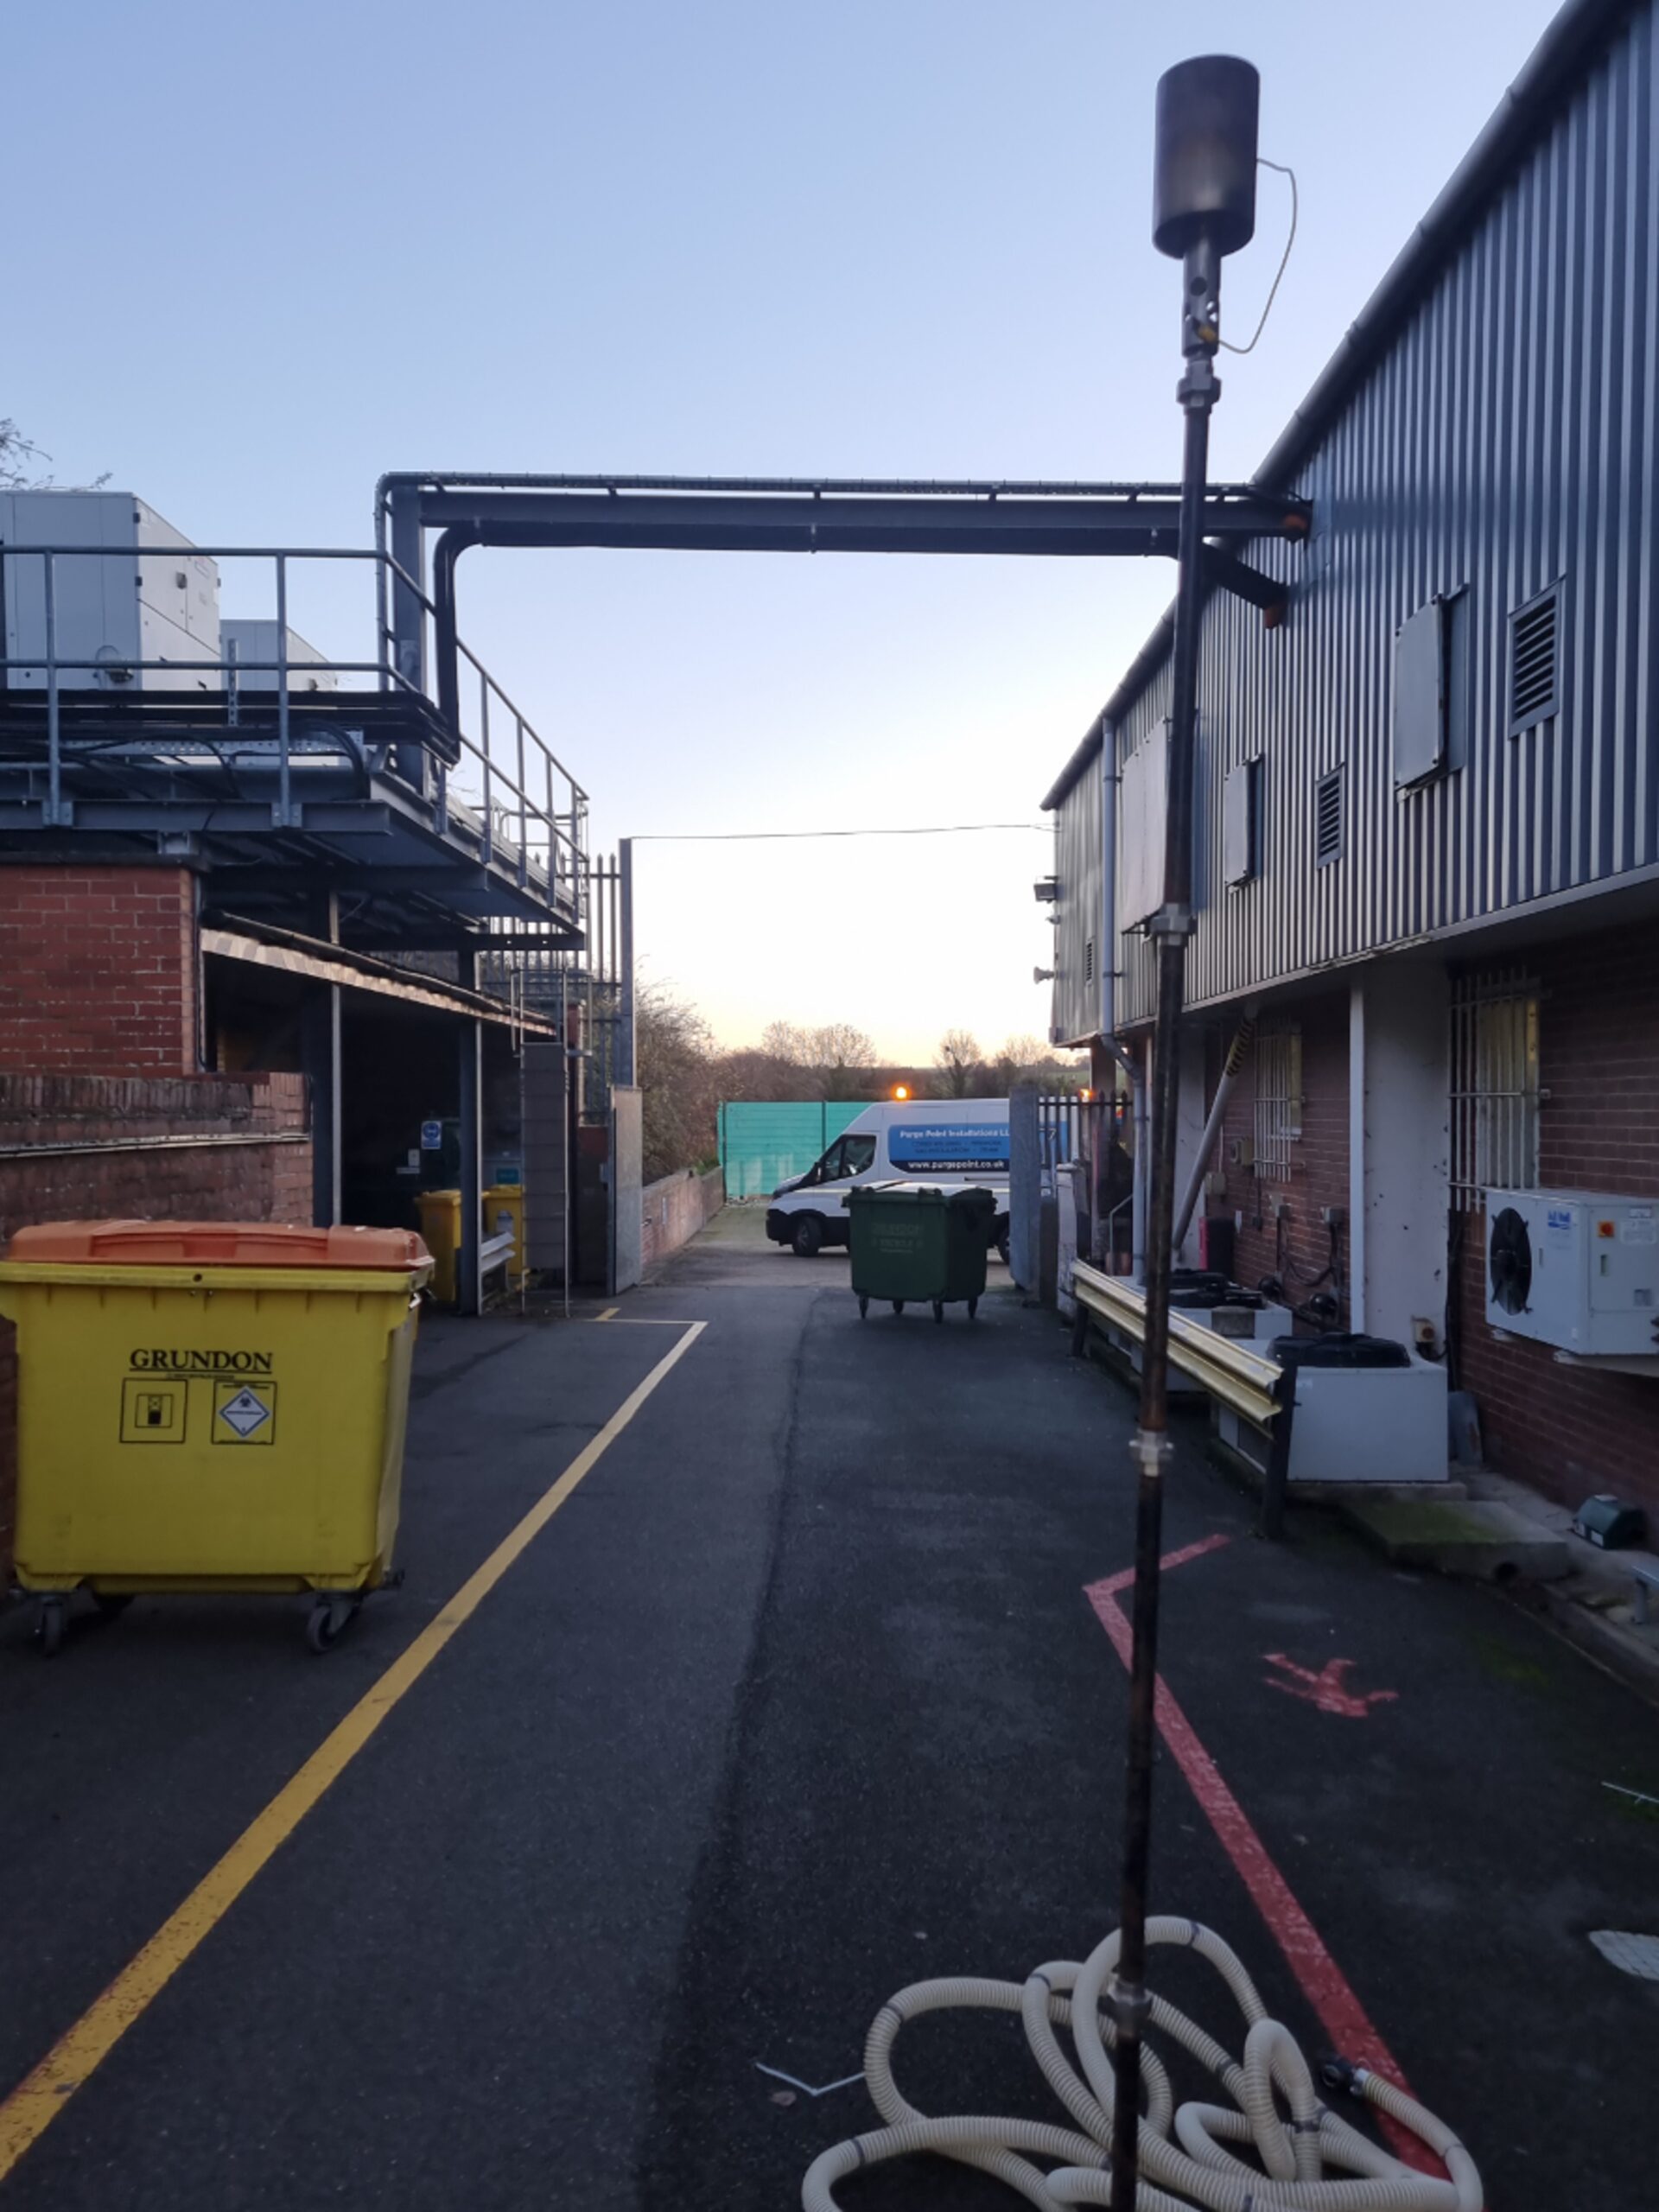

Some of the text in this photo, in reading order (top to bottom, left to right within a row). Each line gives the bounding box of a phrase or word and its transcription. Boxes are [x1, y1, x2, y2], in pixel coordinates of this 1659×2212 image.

[899, 1130, 923, 1139] Purge
[925, 1129, 946, 1138] Point
[949, 1128, 998, 1137] Installations
[908, 1160, 1004, 1170] www.purgepoint.co.uk
[130, 1349, 272, 1370] GRUNDON
